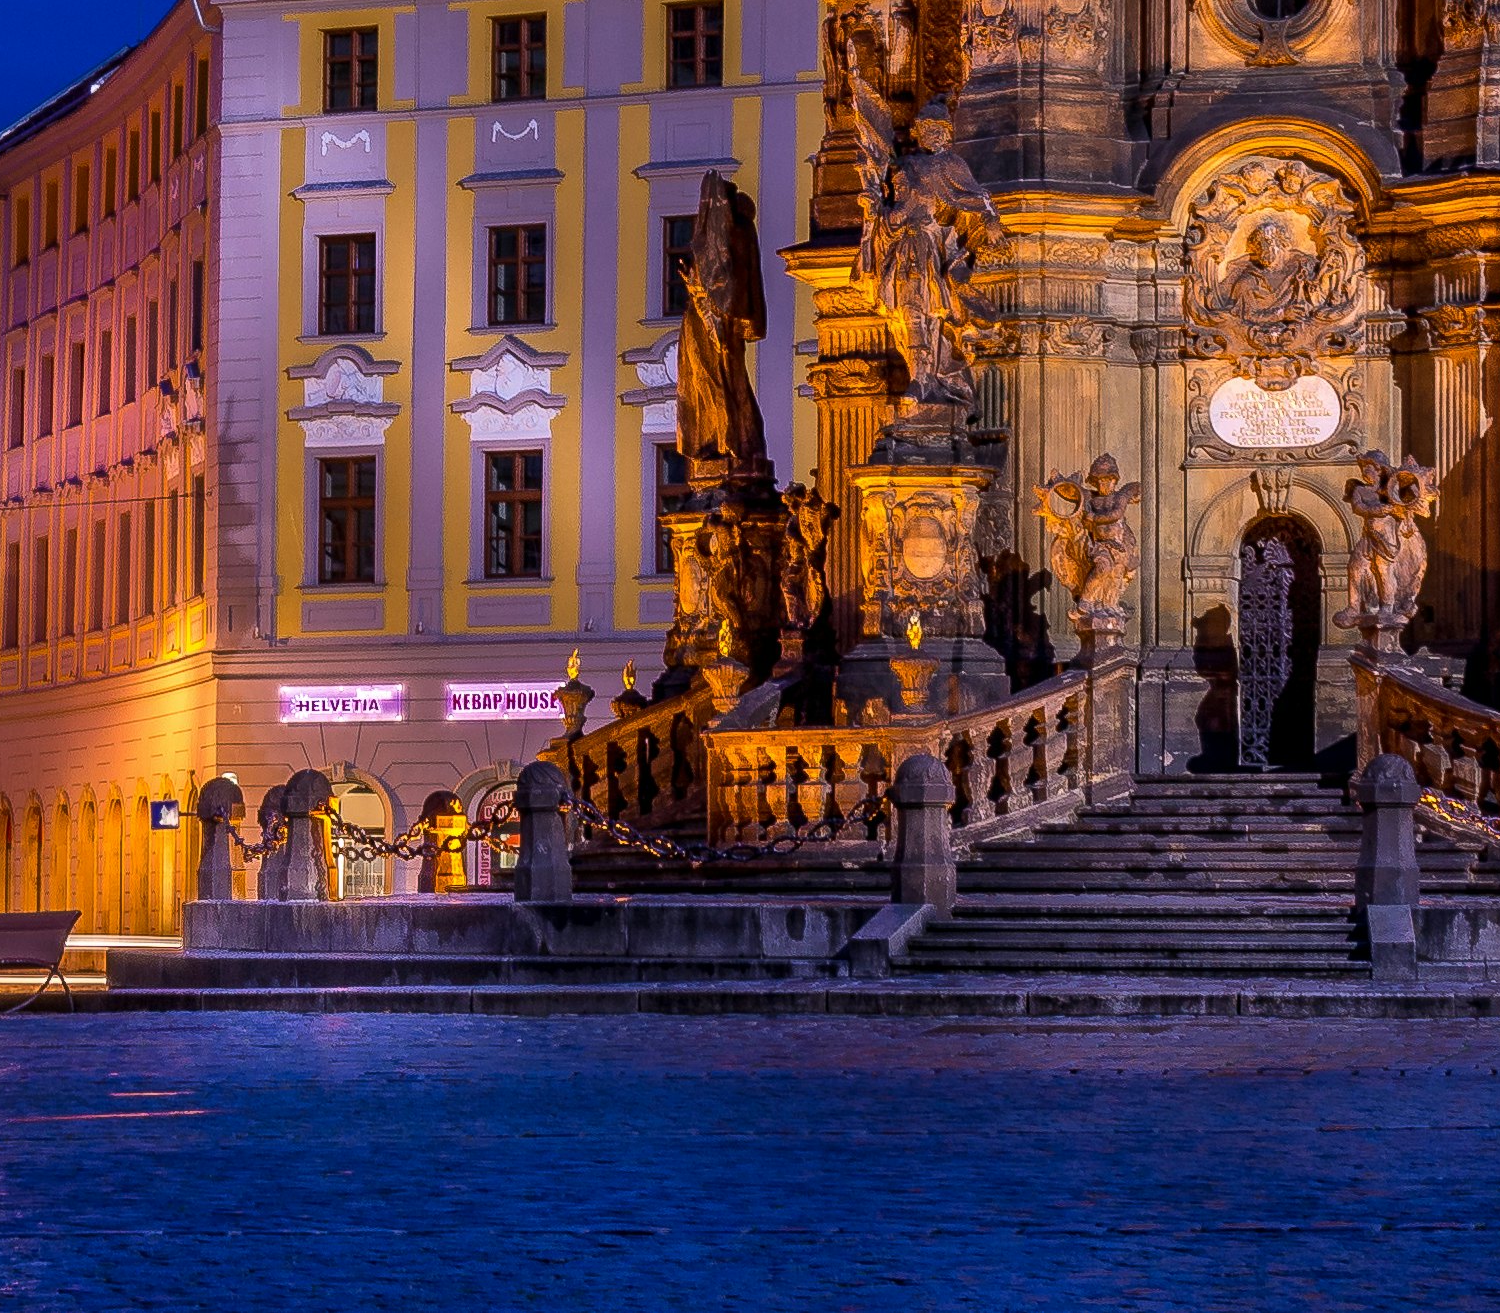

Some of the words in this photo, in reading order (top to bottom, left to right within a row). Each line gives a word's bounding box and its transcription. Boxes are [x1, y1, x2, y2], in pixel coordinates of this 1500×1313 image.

[299, 698, 380, 713] HELVETIA
[452, 692, 502, 712] KEBAP
[505, 691, 559, 711] HOUSE
